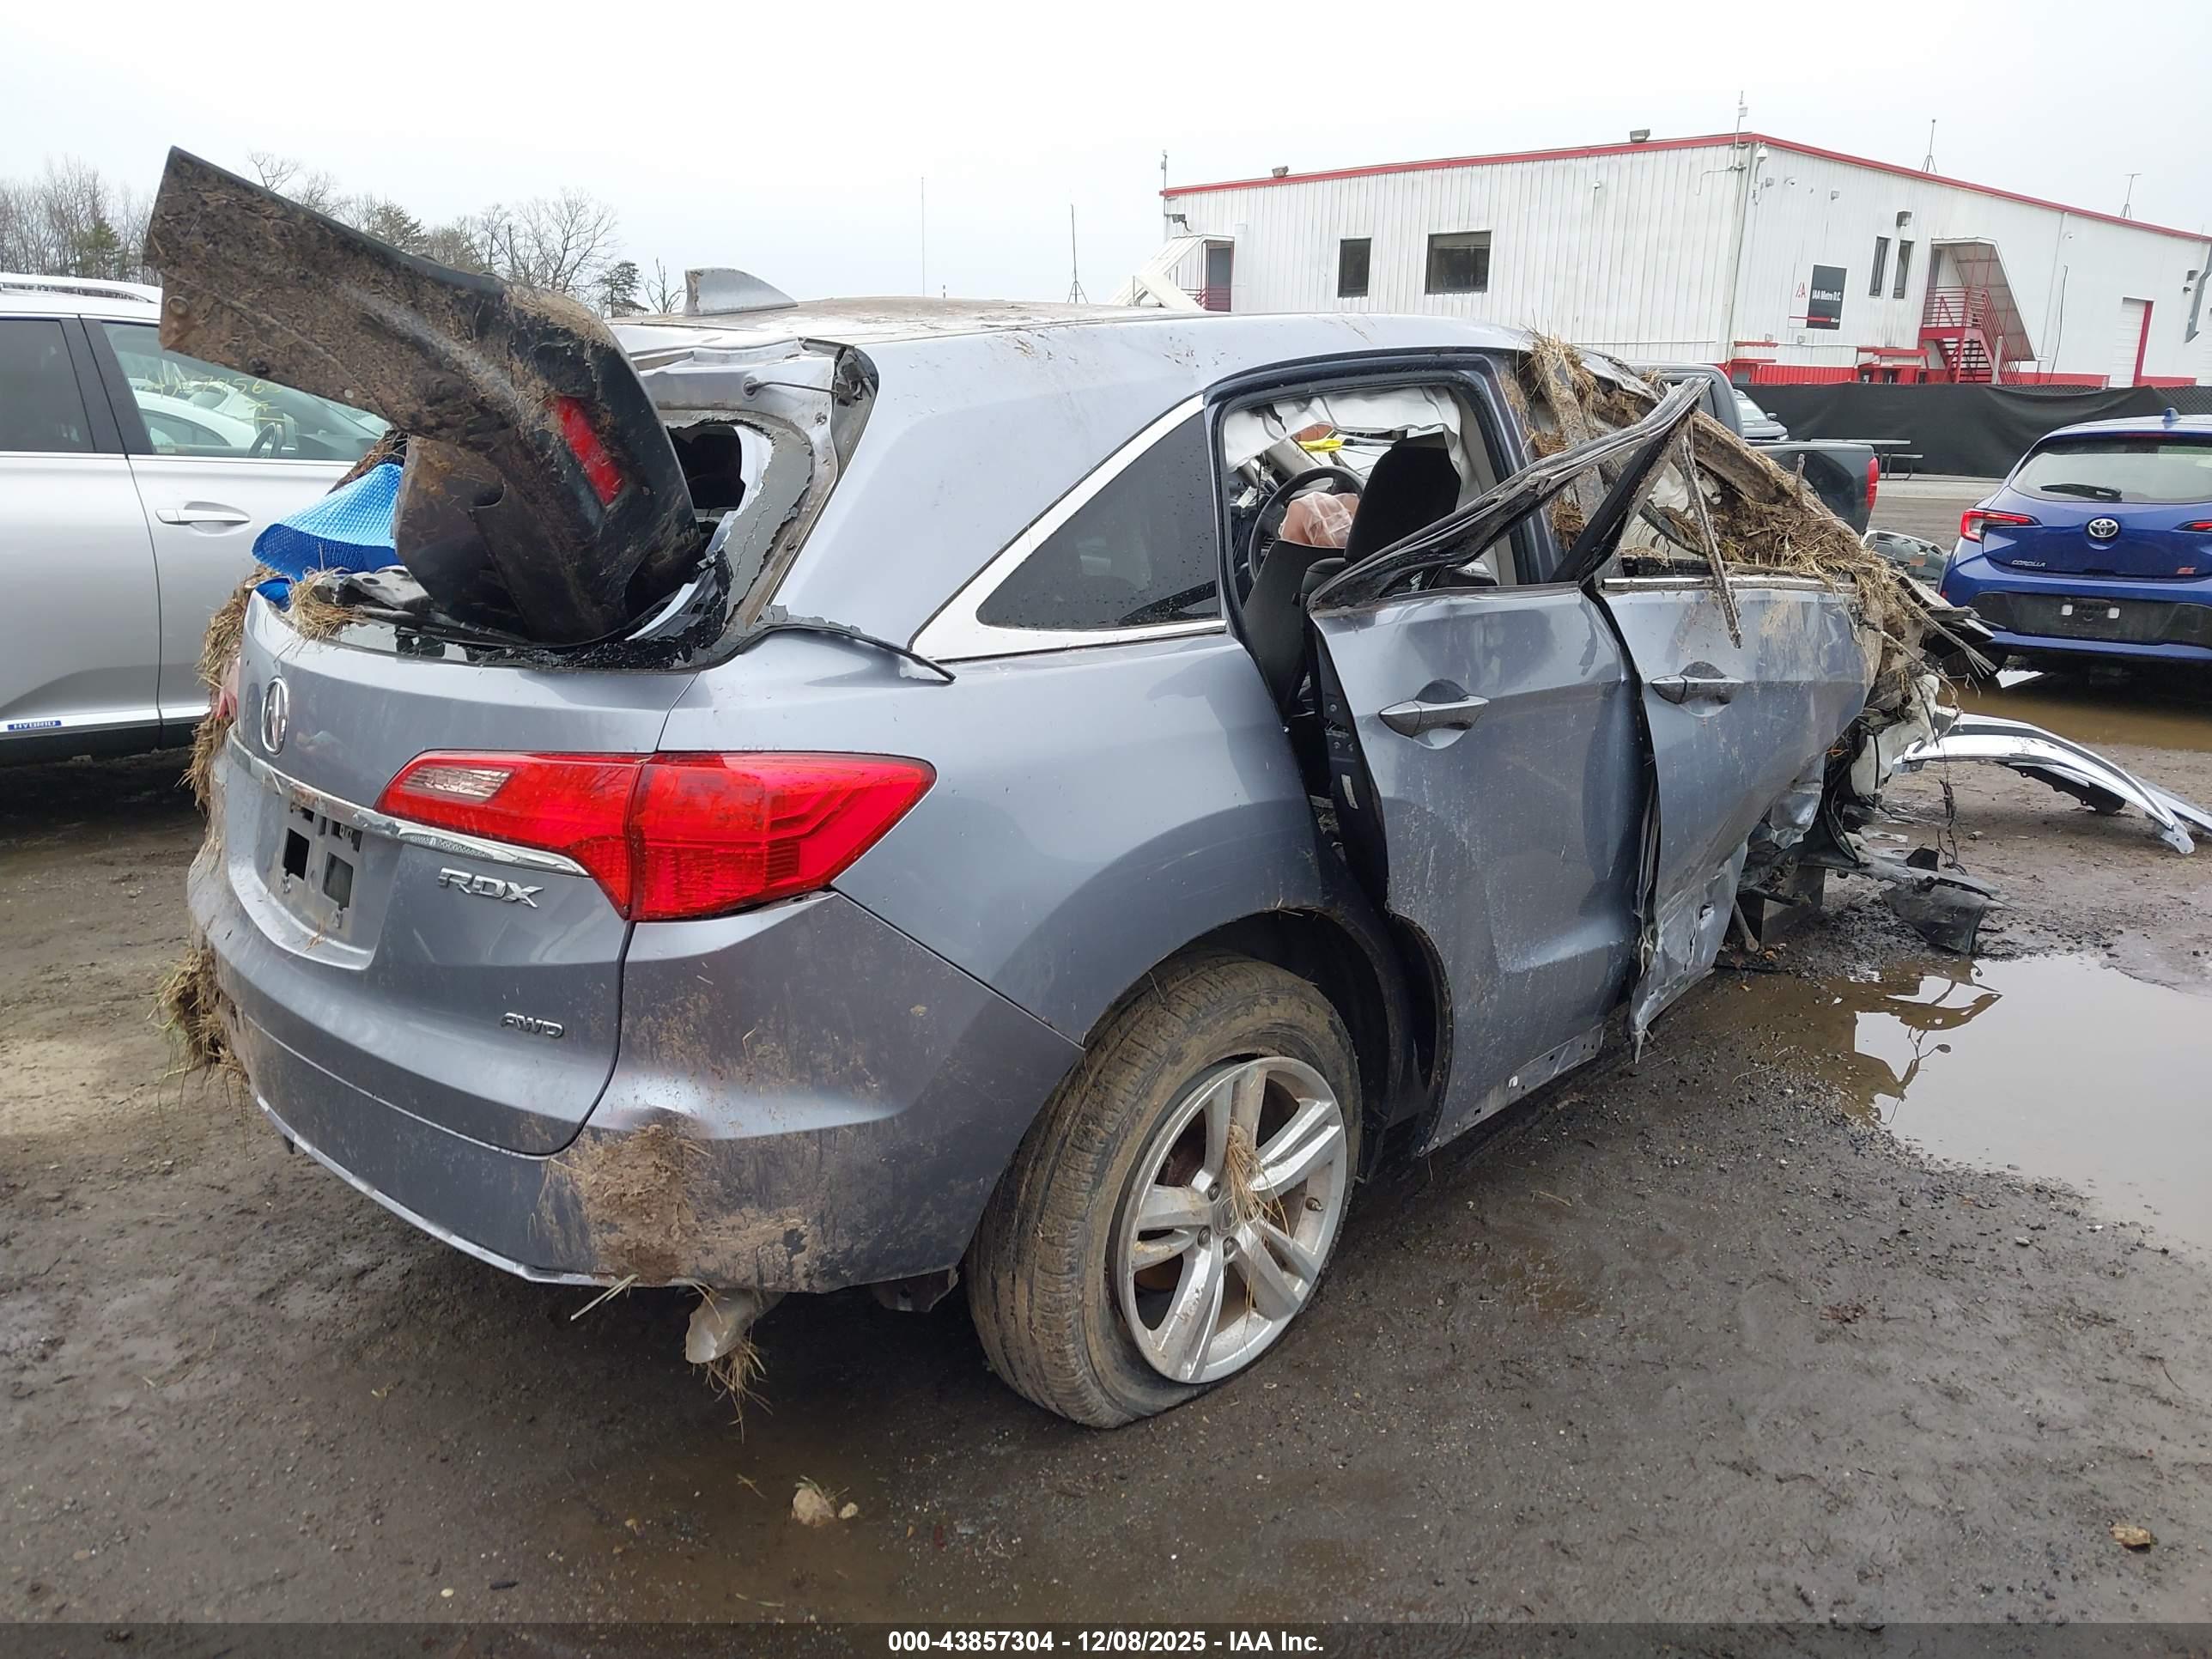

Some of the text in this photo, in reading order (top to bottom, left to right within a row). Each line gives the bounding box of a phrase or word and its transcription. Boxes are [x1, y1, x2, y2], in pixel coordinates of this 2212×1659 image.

[1820, 290, 1832, 301] Metro
[2010, 559, 2046, 568] COROLLA
[15, 721, 55, 730] HYBRID
[437, 866, 544, 909] RDX
[500, 1012, 565, 1039] AWD
